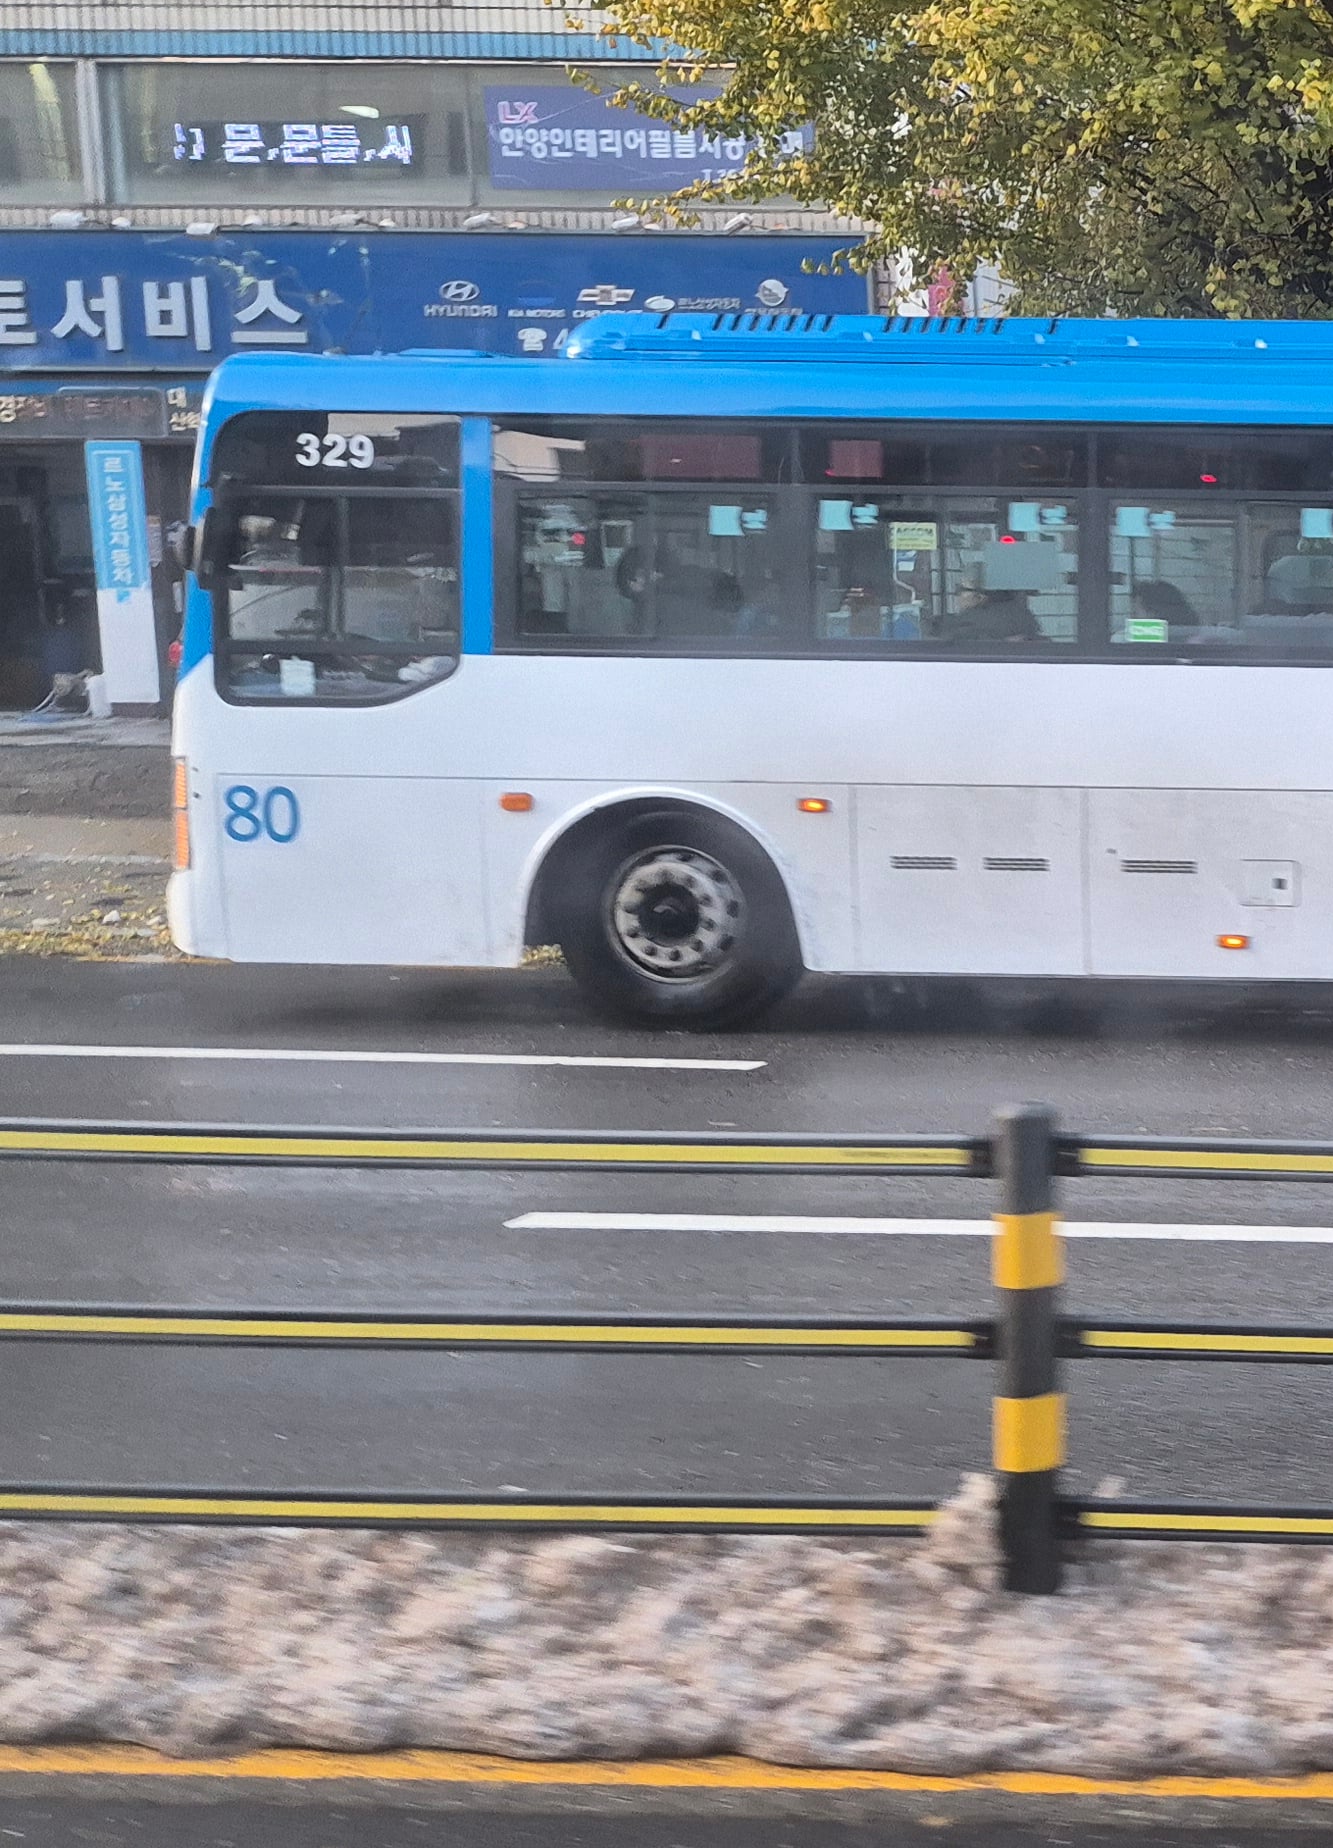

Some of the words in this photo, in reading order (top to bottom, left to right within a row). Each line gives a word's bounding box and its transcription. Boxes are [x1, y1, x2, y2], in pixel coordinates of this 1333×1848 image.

[497, 101, 538, 124] LX
[424, 304, 498, 318] HYUNDAI
[295, 433, 375, 469] 329
[223, 784, 298, 843] 80
